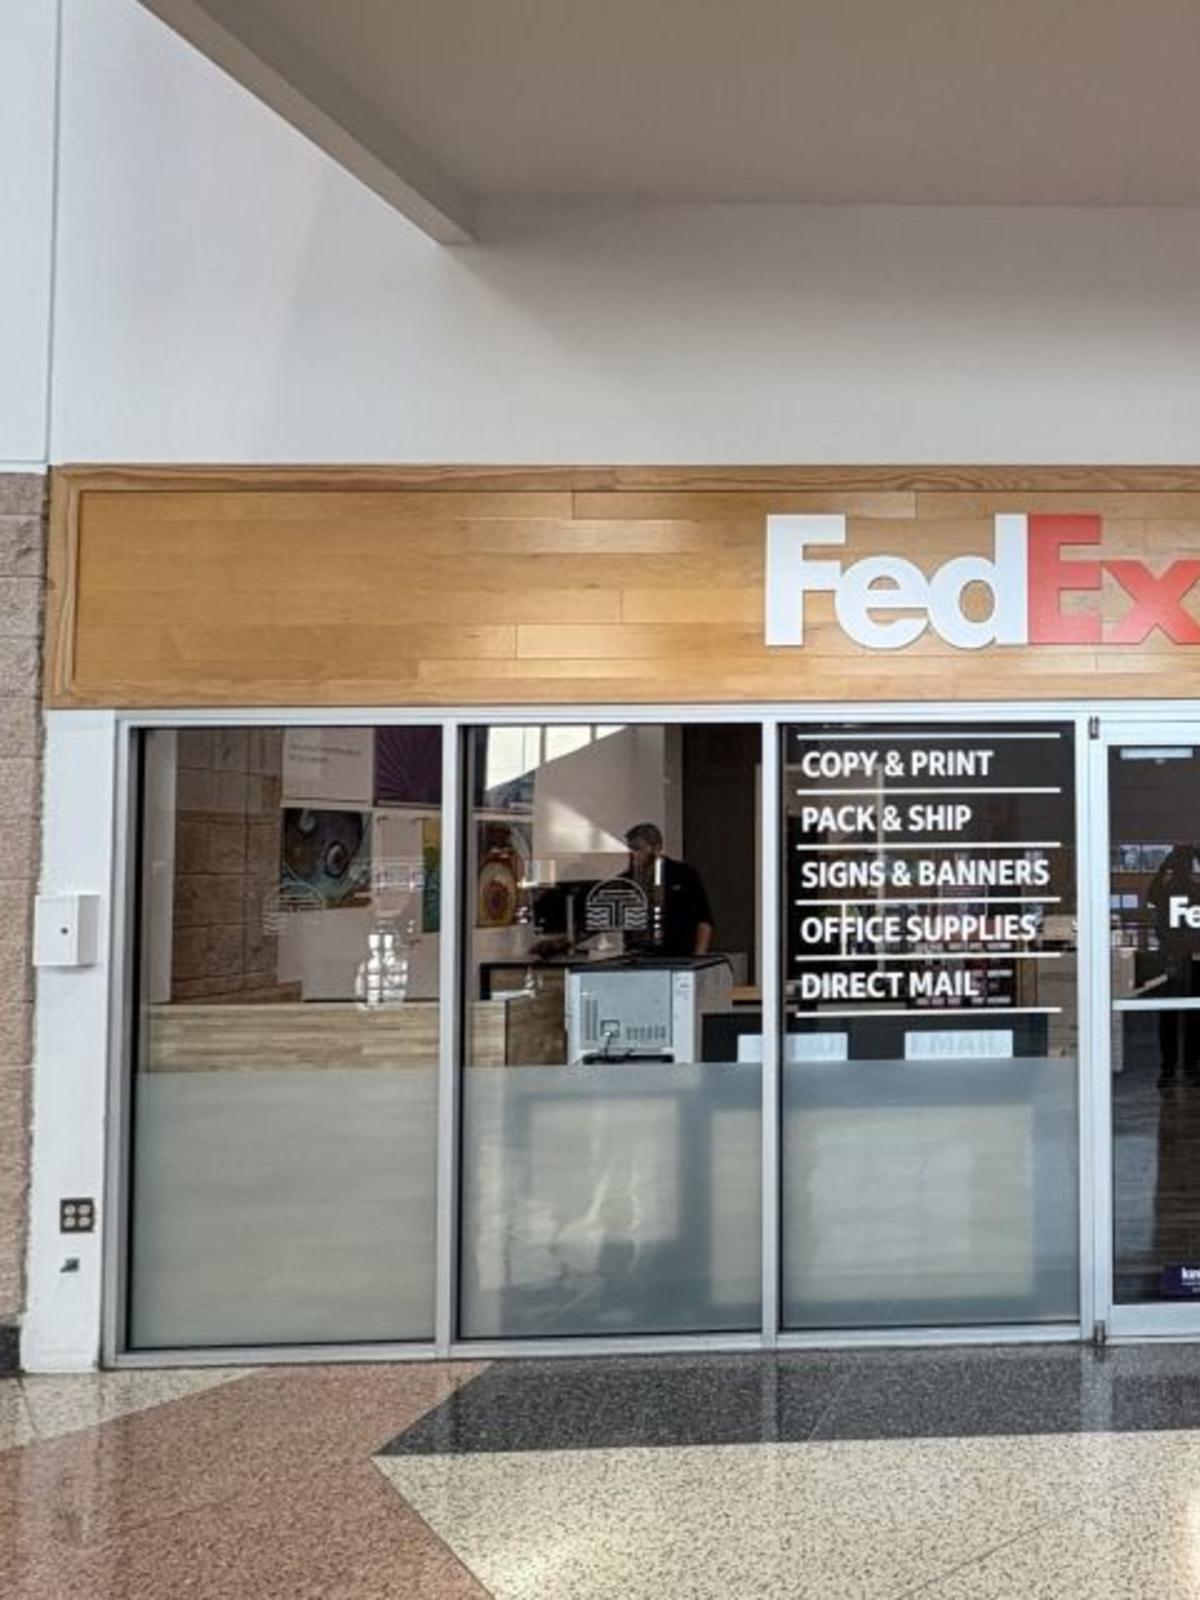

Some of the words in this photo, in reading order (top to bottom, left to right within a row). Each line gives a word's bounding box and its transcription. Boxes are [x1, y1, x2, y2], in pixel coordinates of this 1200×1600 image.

[801, 751, 878, 777] COPY
[883, 750, 904, 777] &
[910, 750, 994, 776] PRINT
[801, 806, 876, 833] PACK
[881, 805, 902, 831] &
[908, 804, 972, 831] SHIP
[801, 861, 886, 888] SIGNS
[891, 860, 911, 887] &
[918, 859, 1050, 886] BANNERS
[801, 916, 901, 943] OFFICE
[906, 914, 1037, 941] SUPPLIES
[801, 972, 904, 999] DIRECT
[909, 971, 980, 997] MAIL
